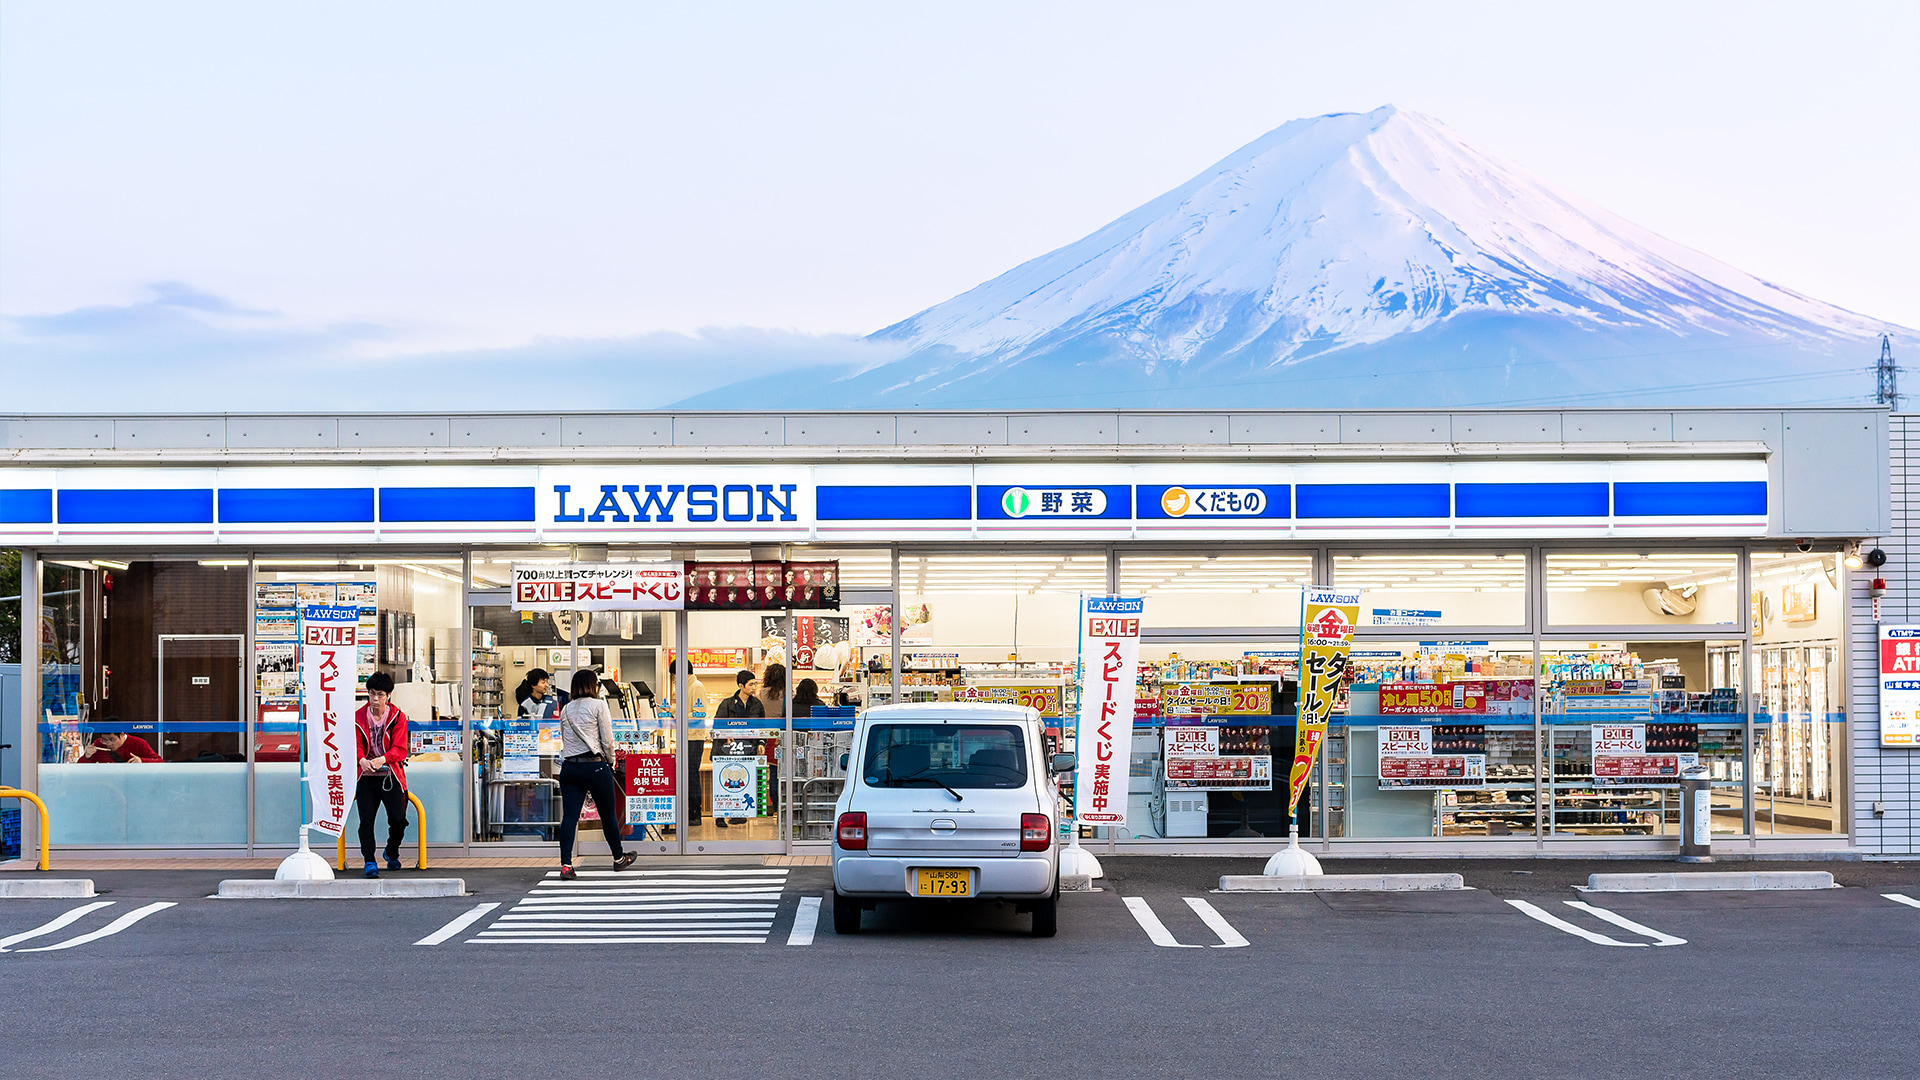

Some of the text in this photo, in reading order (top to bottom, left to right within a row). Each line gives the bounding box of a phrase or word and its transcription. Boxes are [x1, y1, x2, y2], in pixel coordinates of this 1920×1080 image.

[553, 484, 798, 523] LAWSON
[1040, 491, 1093, 513] 野菜
[1194, 491, 1260, 512] くだもの
[520, 580, 681, 602] EXILE スピードくじ
[1310, 593, 1360, 604] LAWSON
[1089, 600, 1141, 611] LAWSON
[306, 608, 357, 619] LAWSON
[1092, 619, 1137, 636] EXILE
[307, 627, 353, 645] EXILE
[1166, 697, 1231, 706] タイムセールの日!
[1177, 731, 1205, 742] EXILE
[1391, 731, 1419, 741] EXILE
[1604, 729, 1632, 740] EXILE
[730, 741, 745, 750] 24
[1168, 743, 1216, 752] スピードくじ
[1381, 741, 1429, 751] スピードくじ
[1595, 740, 1642, 749] スピードくじ
[640, 758, 661, 767] TAX
[637, 768, 664, 777] FREE
[652, 777, 669, 786] 면세
[931, 880, 967, 893] 17-93
